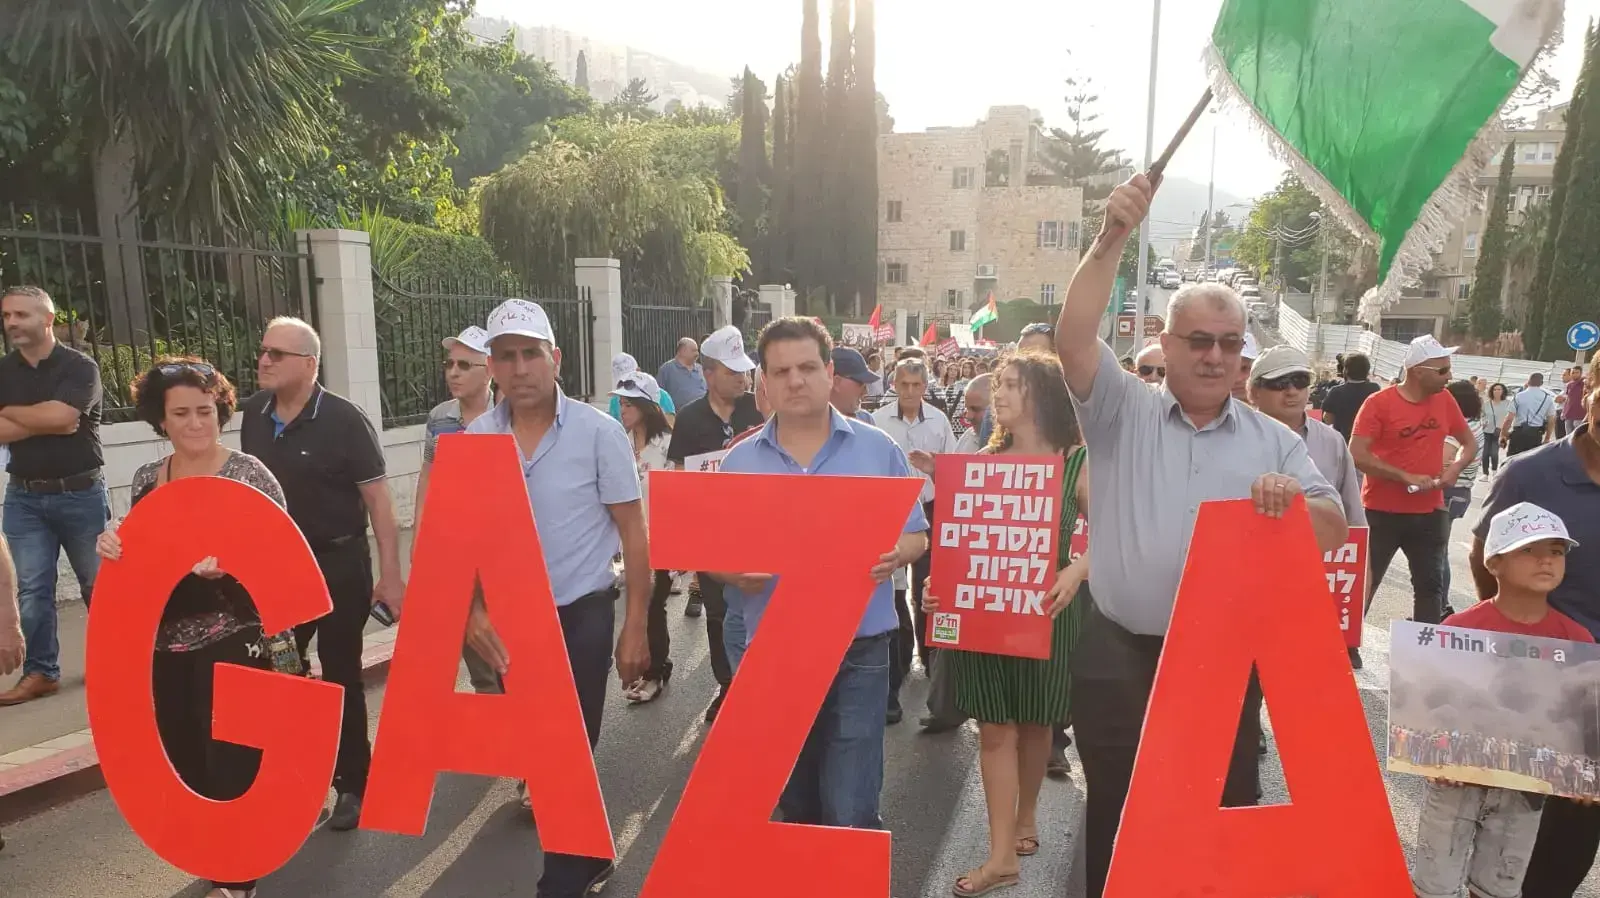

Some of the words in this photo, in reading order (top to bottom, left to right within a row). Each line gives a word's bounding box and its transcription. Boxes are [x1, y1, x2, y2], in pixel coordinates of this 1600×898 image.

[964, 462, 1054, 490] יהודים
[953, 493, 1053, 522] וערבים
[939, 522, 1051, 554] מסרבים
[967, 554, 1049, 584] להיות
[955, 584, 1047, 616] אויבים
[1417, 626, 1566, 663] #Think_Gaza
